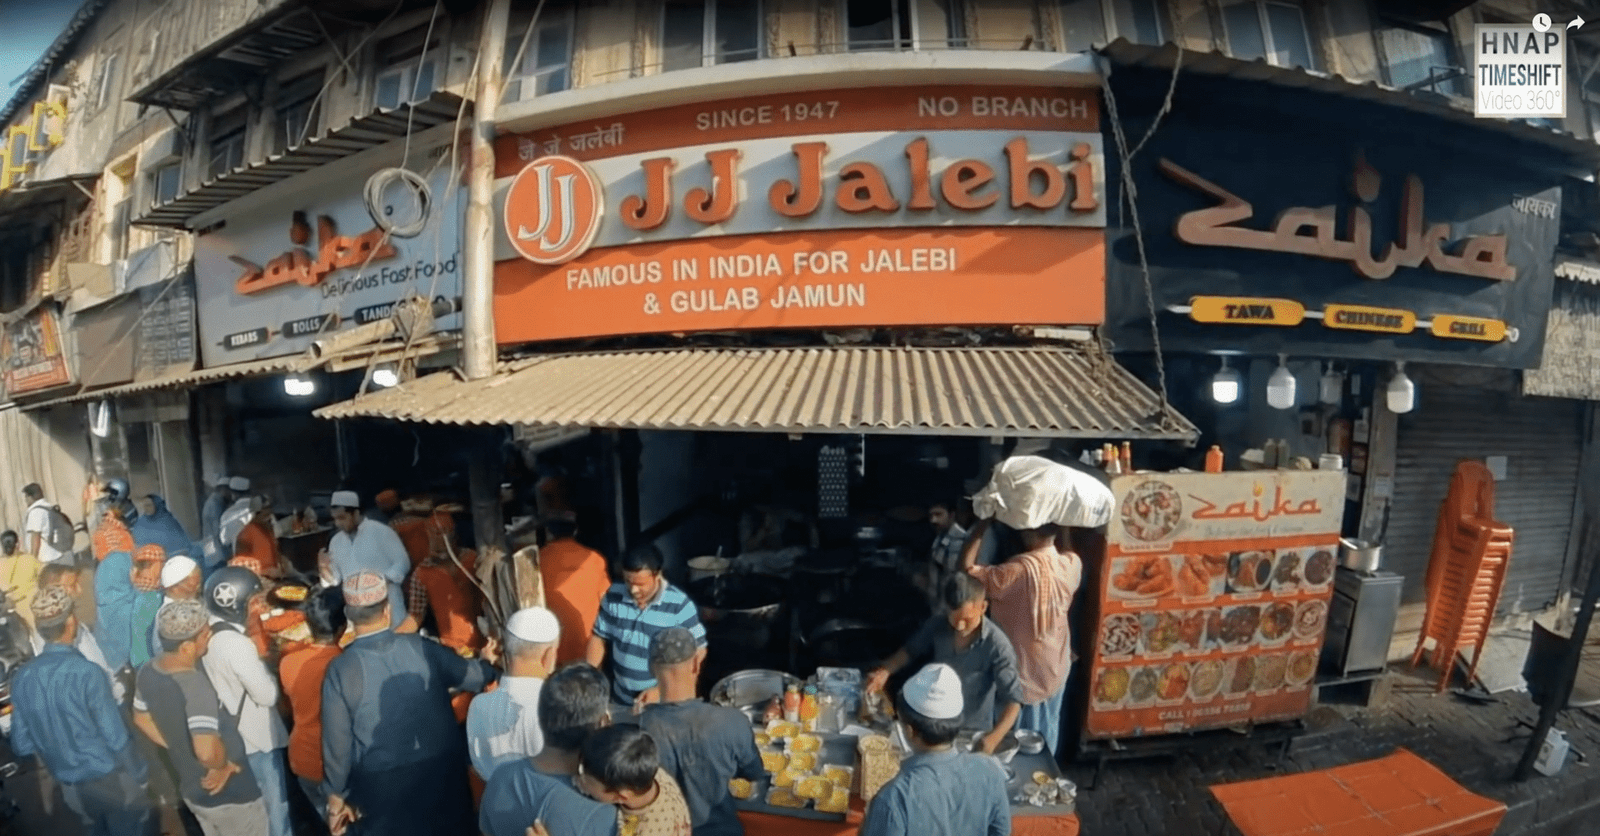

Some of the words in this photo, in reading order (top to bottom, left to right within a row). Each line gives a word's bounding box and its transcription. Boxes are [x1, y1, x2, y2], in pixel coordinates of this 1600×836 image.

[696, 105, 773, 131] SINCE
[780, 100, 841, 123] 1947
[917, 96, 959, 118] NO
[971, 96, 1089, 119] BRANCH
[767, 136, 1099, 219] Jalebi
[566, 260, 662, 291] FAMOUS
[672, 257, 699, 282] IN
[709, 253, 783, 279] INDIA
[792, 250, 850, 276] FOR
[859, 247, 957, 273] JALEBI
[642, 292, 662, 315] &
[670, 286, 760, 313] GULAB
[770, 282, 866, 309] JAMUN
[1223, 303, 1276, 321] TAWA
